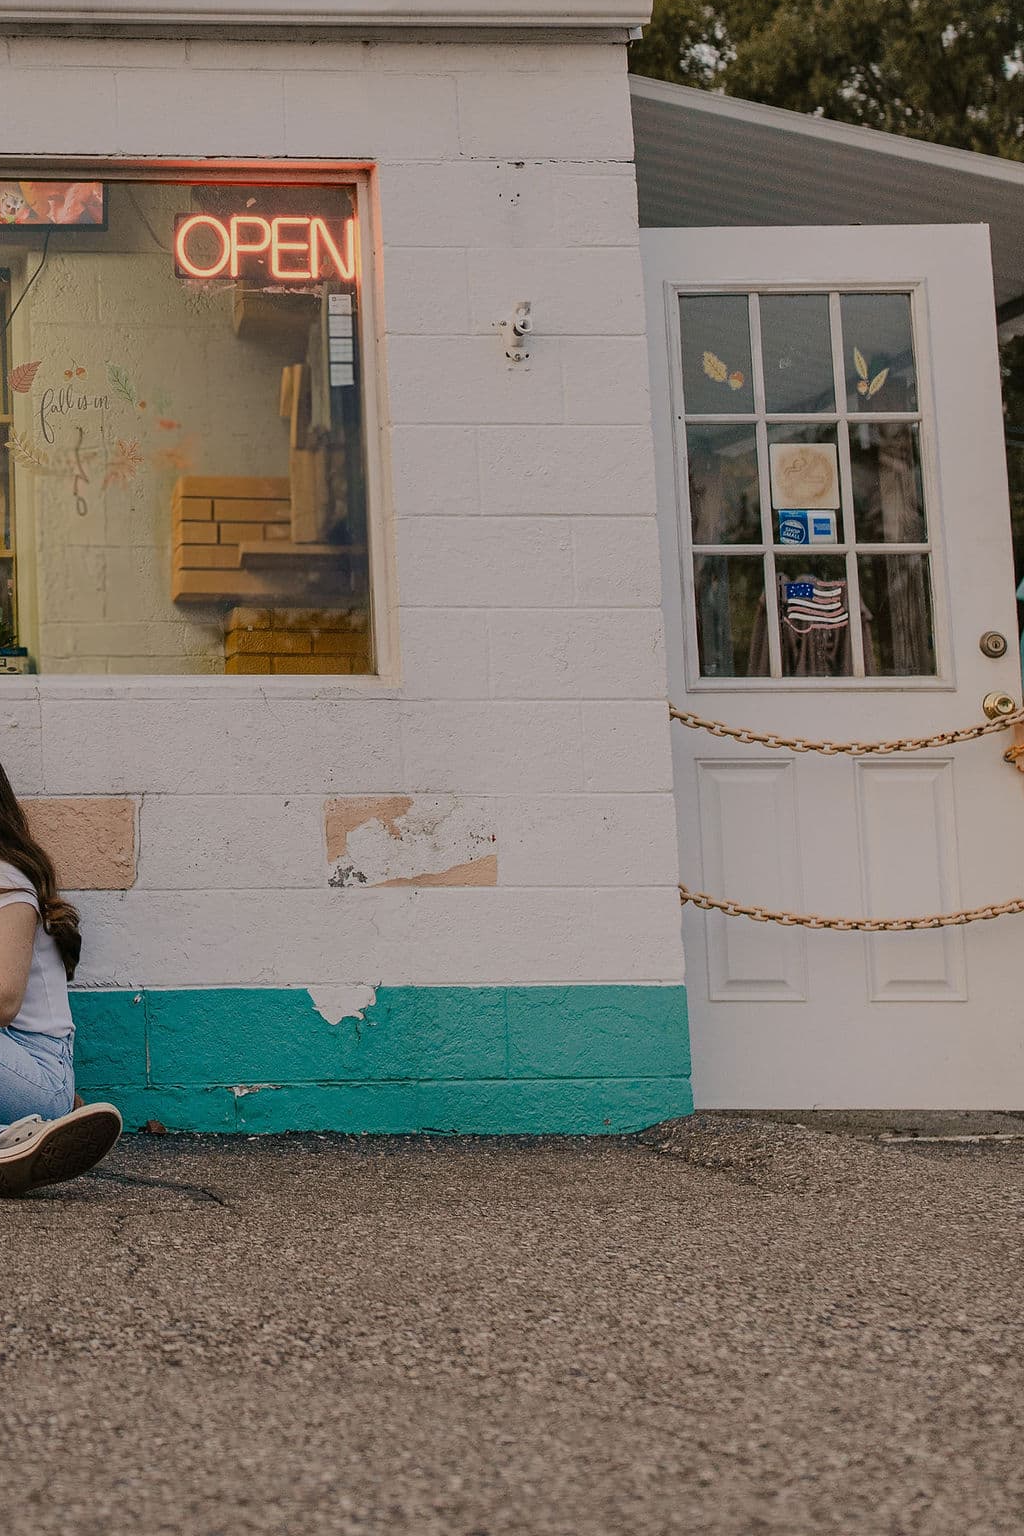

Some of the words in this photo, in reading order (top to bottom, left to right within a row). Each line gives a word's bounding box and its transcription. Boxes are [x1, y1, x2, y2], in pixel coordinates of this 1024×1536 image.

[176, 214, 355, 280] OPEN
[35, 384, 74, 444] fall
[77, 394, 91, 410] is
[94, 393, 111, 410] in
